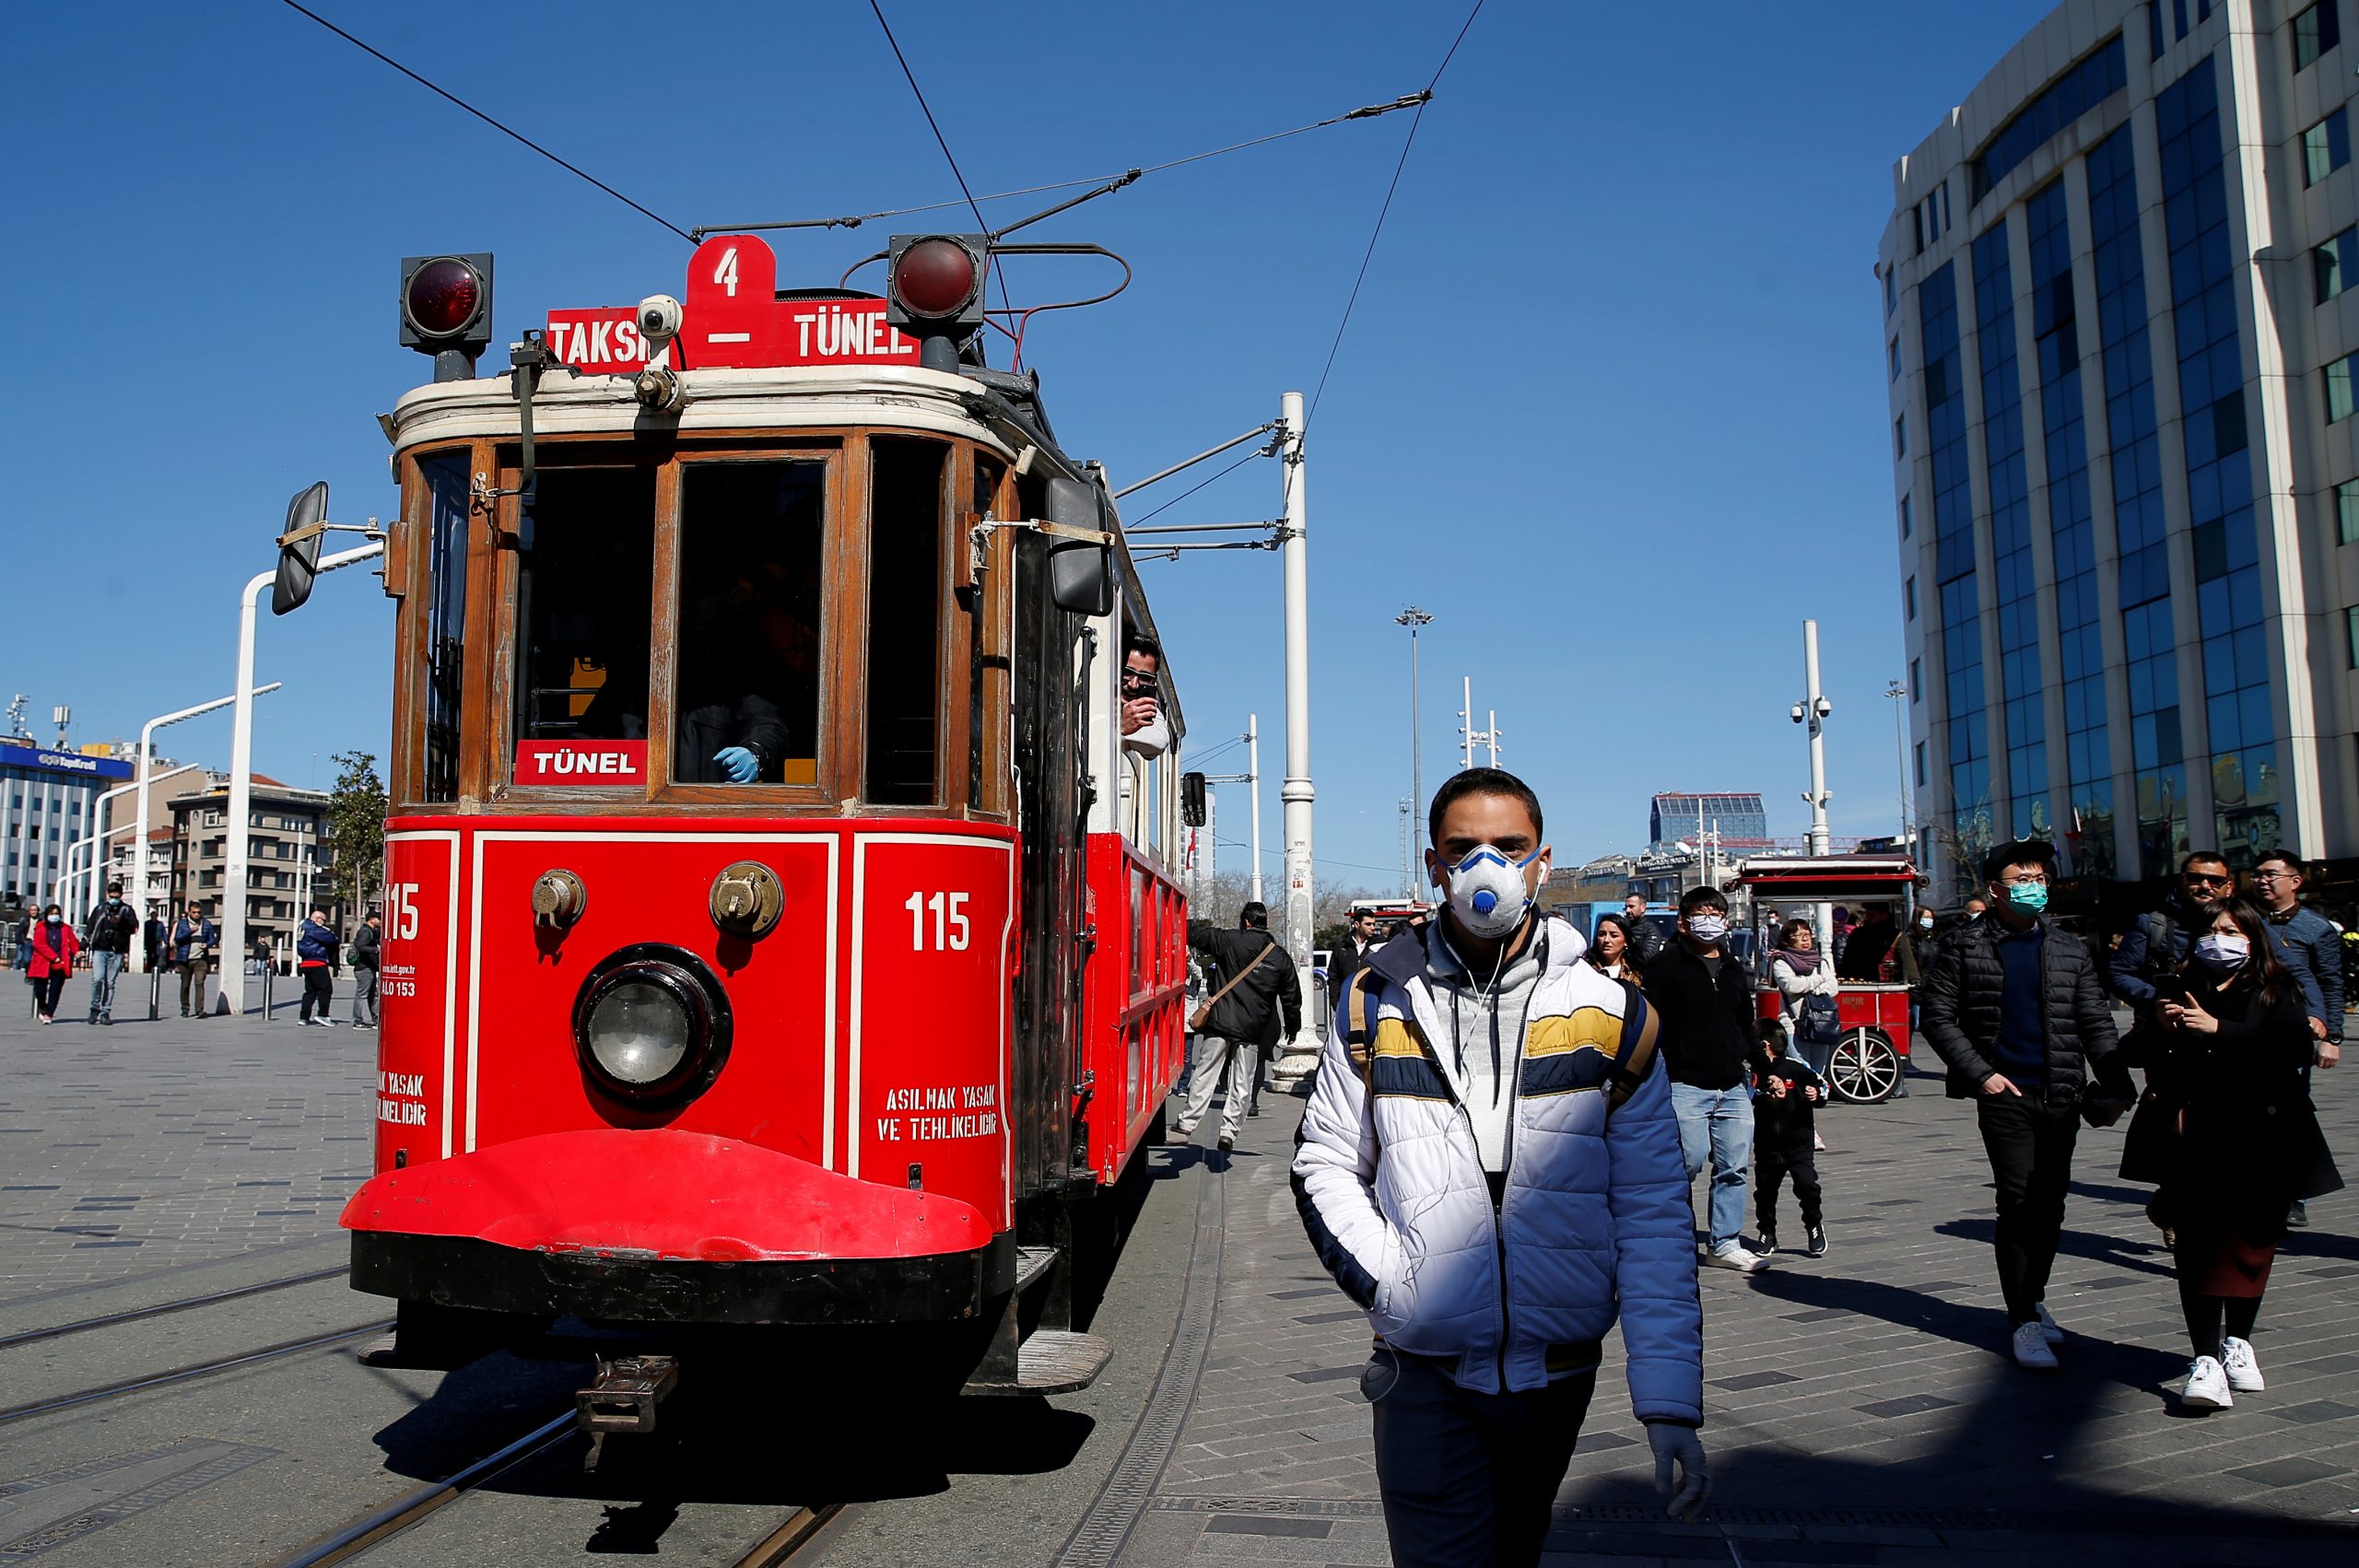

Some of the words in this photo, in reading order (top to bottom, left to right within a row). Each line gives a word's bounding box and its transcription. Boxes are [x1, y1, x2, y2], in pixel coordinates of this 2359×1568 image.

[713, 248, 739, 297] 4
[793, 306, 913, 357] TÜNEL
[534, 748, 637, 774] TÜNEL
[383, 883, 419, 941] 115
[905, 891, 969, 951] 115
[396, 982, 416, 998] 153
[388, 1071, 424, 1097] YASAK
[886, 1087, 957, 1111] ASILMAK
[962, 1084, 995, 1109] YASAK
[877, 1117, 901, 1141] VE
[910, 1110, 997, 1141] TEHLİKELİDİR
